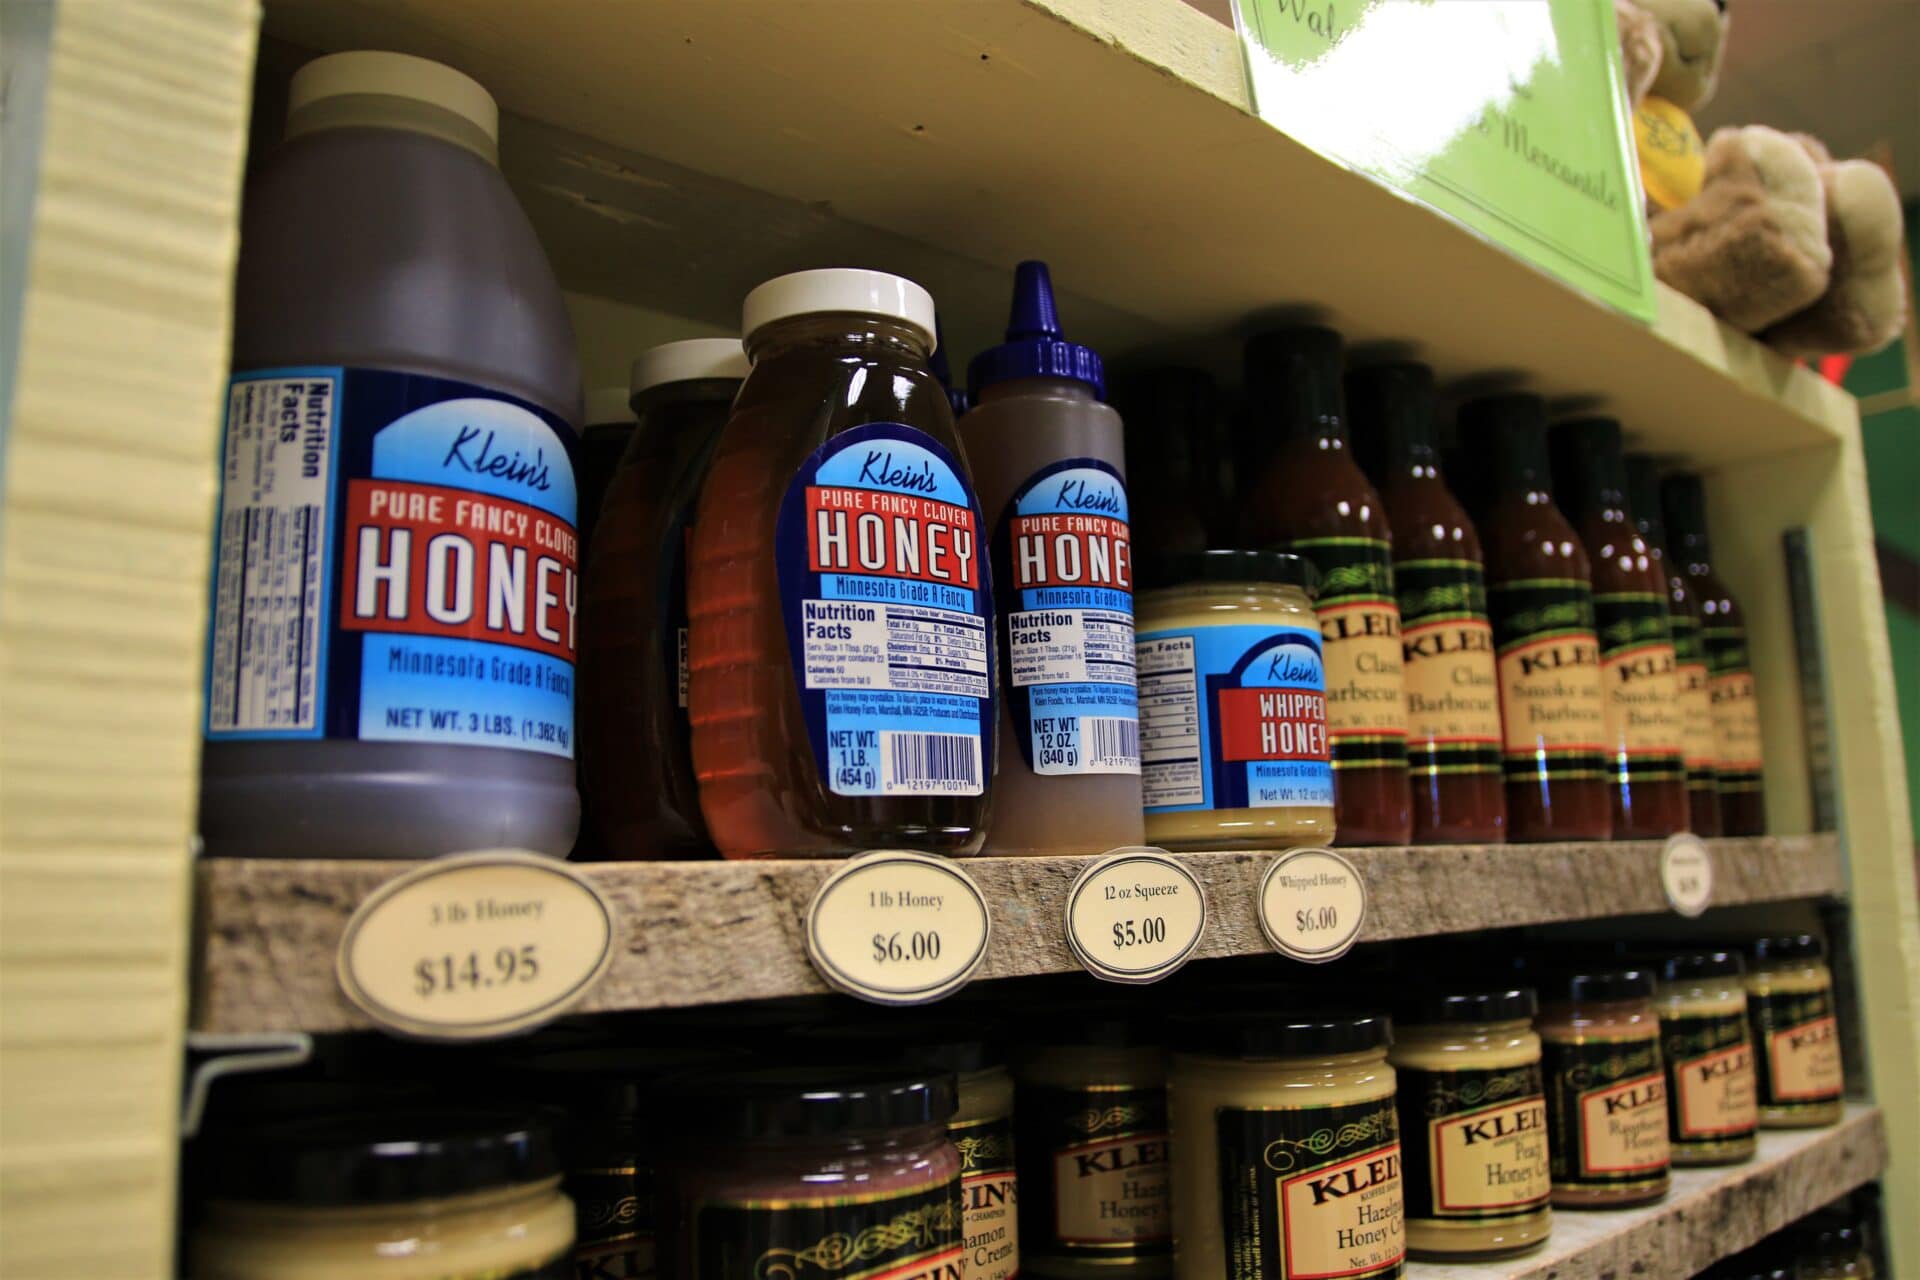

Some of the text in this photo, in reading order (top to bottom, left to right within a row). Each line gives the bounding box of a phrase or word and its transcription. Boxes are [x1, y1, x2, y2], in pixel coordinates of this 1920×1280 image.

[280, 383, 305, 443] Facts
[302, 383, 330, 478] Nutrition
[443, 424, 551, 492] Klein's
[858, 450, 938, 493] Klein's
[820, 489, 968, 527] PURE FANCY CLOVER
[1055, 479, 1121, 514] Klein's
[370, 489, 444, 524] PURE
[456, 499, 528, 539] FANCY
[1021, 516, 1061, 533] PURE
[1066, 516, 1108, 534] FANCY
[816, 509, 972, 583] HONEY
[1018, 533, 1132, 588] HONE
[354, 526, 578, 651] HONEY
[836, 575, 966, 611] Minnesota Grade A Fancy
[1036, 589, 1091, 606] Minnesota
[805, 602, 875, 622] Nutrition
[1010, 611, 1073, 630] Nutrition
[806, 621, 852, 640] Facts
[1011, 629, 1052, 646] Facts
[1157, 637, 1192, 652] Facts
[388, 646, 485, 682] Minnesota
[491, 655, 532, 687] Grade
[535, 664, 543, 689] A
[1267, 652, 1319, 684] Klein's
[386, 707, 425, 730] NET
[430, 708, 463, 732] WT.
[468, 712, 479, 733] 3
[484, 713, 517, 737] LBS.
[1033, 716, 1080, 734] NET WT.
[829, 730, 878, 749] NET WT.
[1039, 732, 1076, 749] 12 OZ.
[1261, 721, 1327, 755] HONEY
[840, 750, 870, 767] 1 LB.
[1039, 748, 1079, 769] (340 g)
[1255, 764, 1299, 778] Minnesota
[835, 768, 876, 790] (454 g)
[1259, 788, 1278, 801] Net
[1104, 883, 1179, 901] 12 oz Squeeze
[1279, 872, 1348, 892] Whipped Honey
[475, 898, 544, 922] Honey
[869, 891, 944, 911] 1 lb Honey
[1112, 916, 1166, 950] $5.00
[1296, 906, 1338, 934] $6.00
[872, 930, 941, 965] $6.00
[413, 944, 540, 997] $14.95
[1460, 1107, 1544, 1147] KLEI
[1336, 1228, 1389, 1251] Honey
